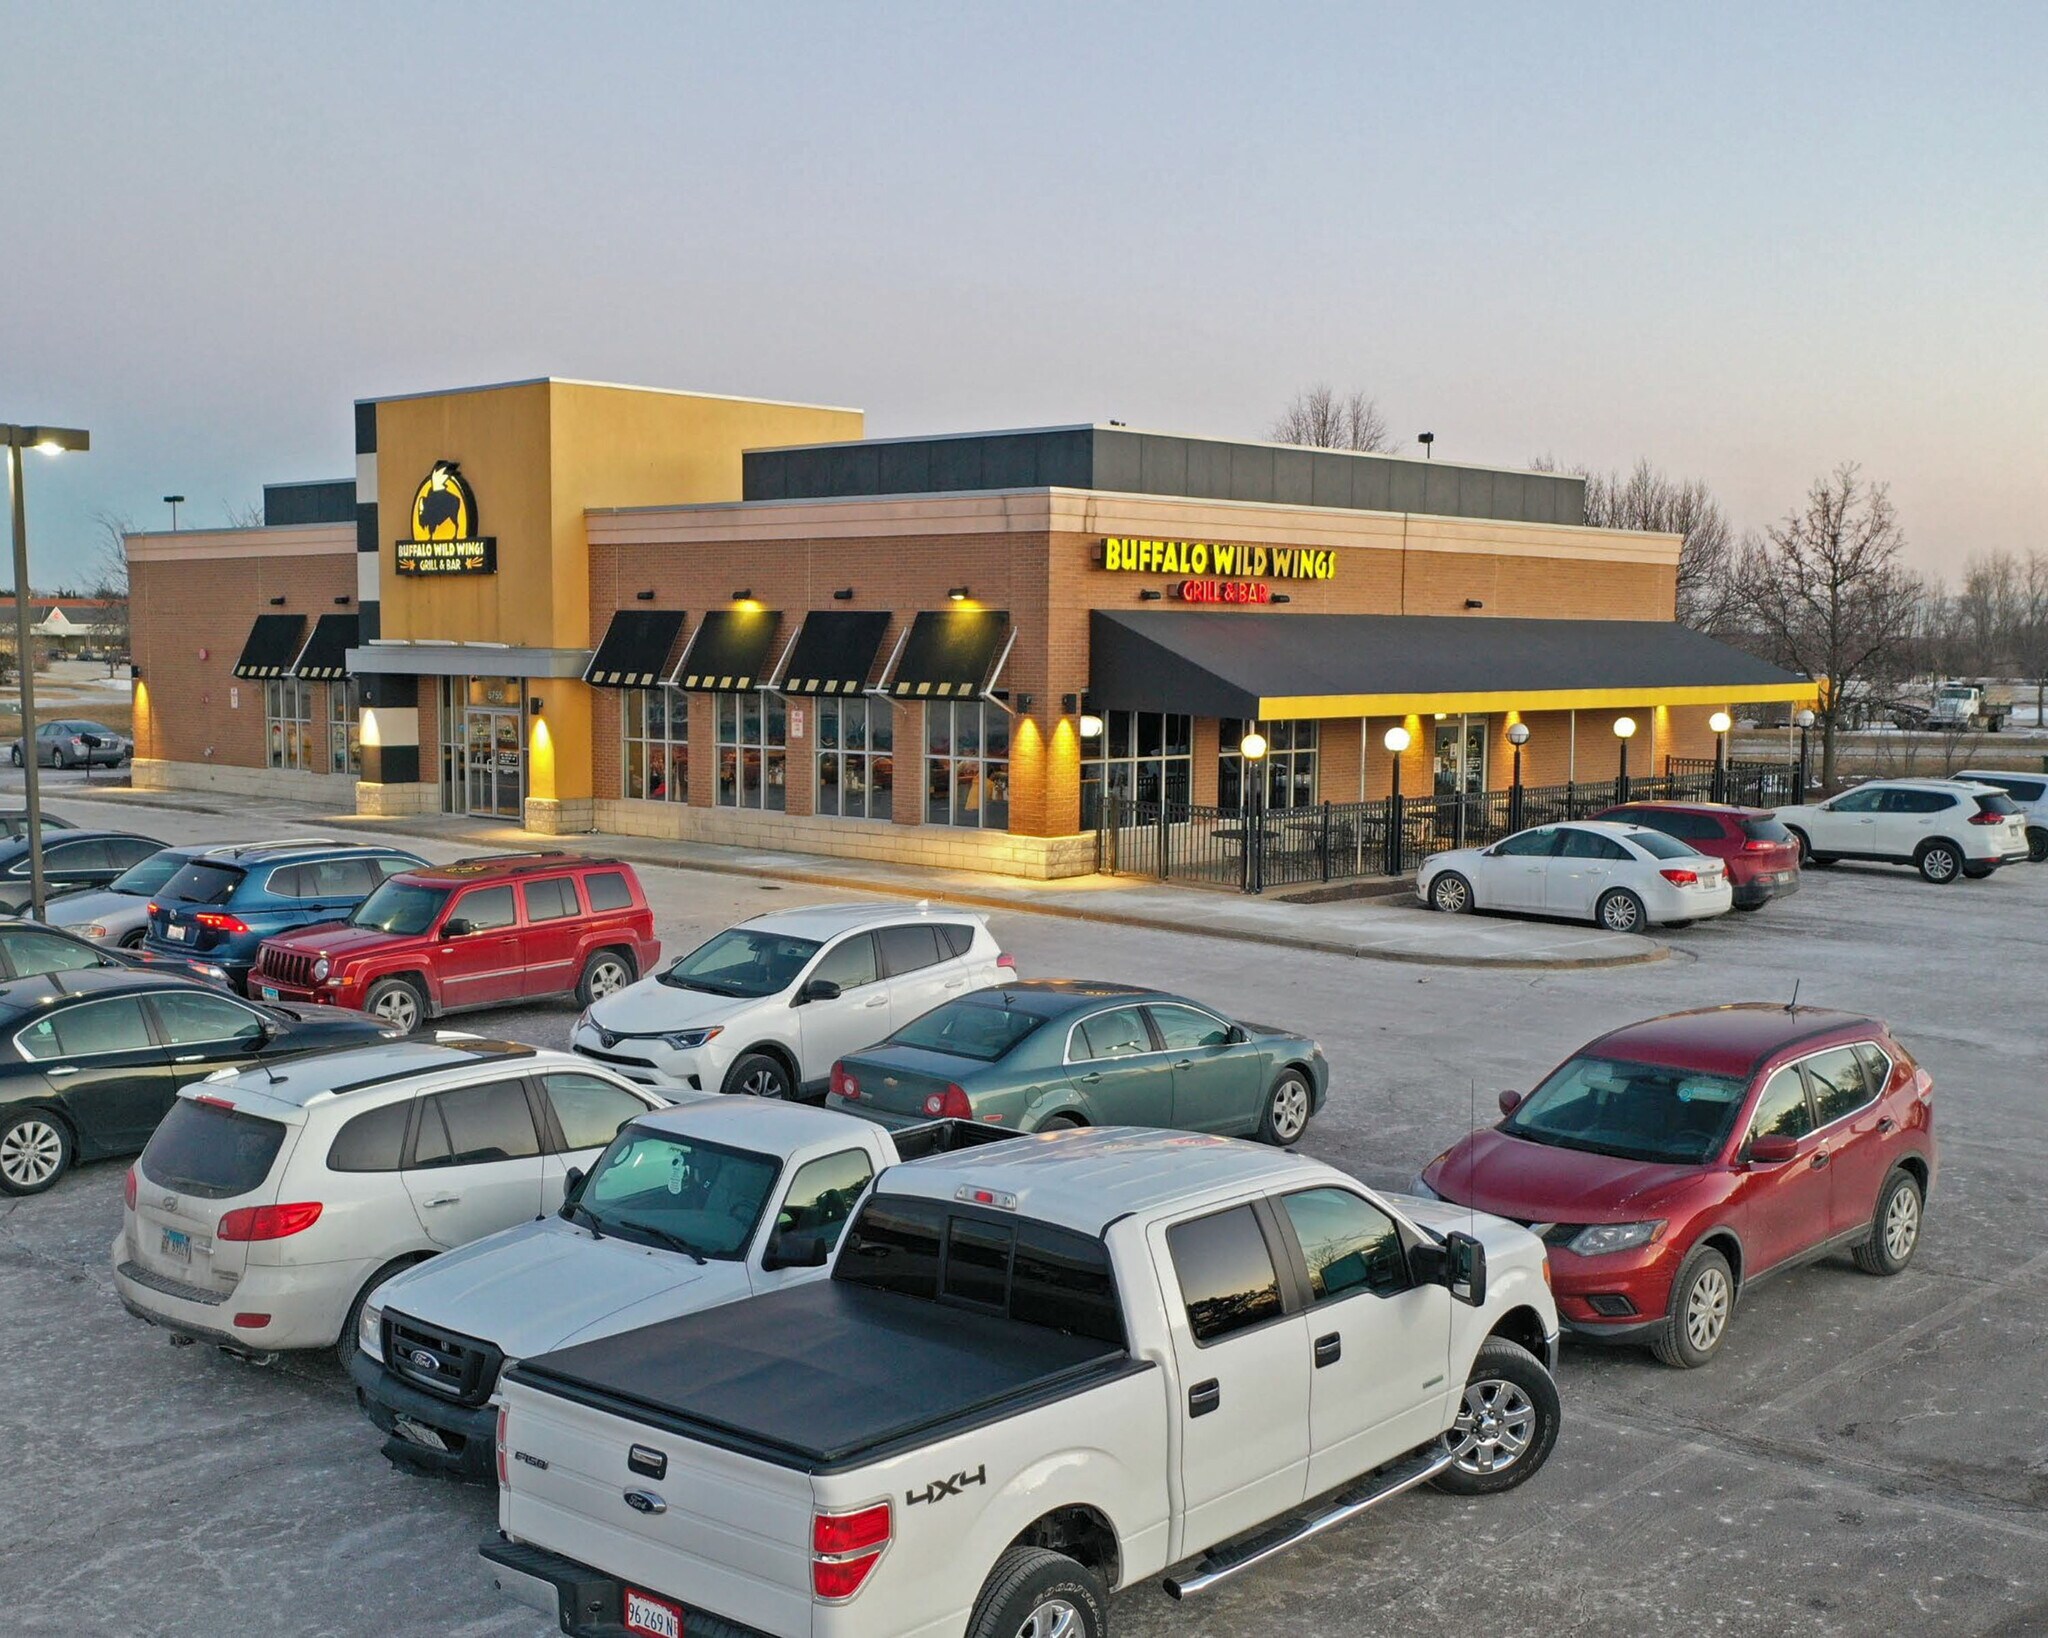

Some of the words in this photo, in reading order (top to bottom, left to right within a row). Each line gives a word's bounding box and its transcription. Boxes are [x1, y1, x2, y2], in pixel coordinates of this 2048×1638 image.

[398, 543, 432, 557] BUFFALO
[433, 542, 455, 556] WILD
[456, 541, 484, 555] WINGS
[1105, 537, 1208, 574] BUFFALO
[1213, 544, 1268, 576] WILD
[1272, 547, 1336, 579] WINGS
[420, 559, 438, 571] GRILL
[440, 559, 446, 570] &
[446, 559, 461, 570] BAR
[1183, 580, 1221, 602] GRILL
[1224, 581, 1236, 602] &
[1238, 582, 1269, 604] BAR
